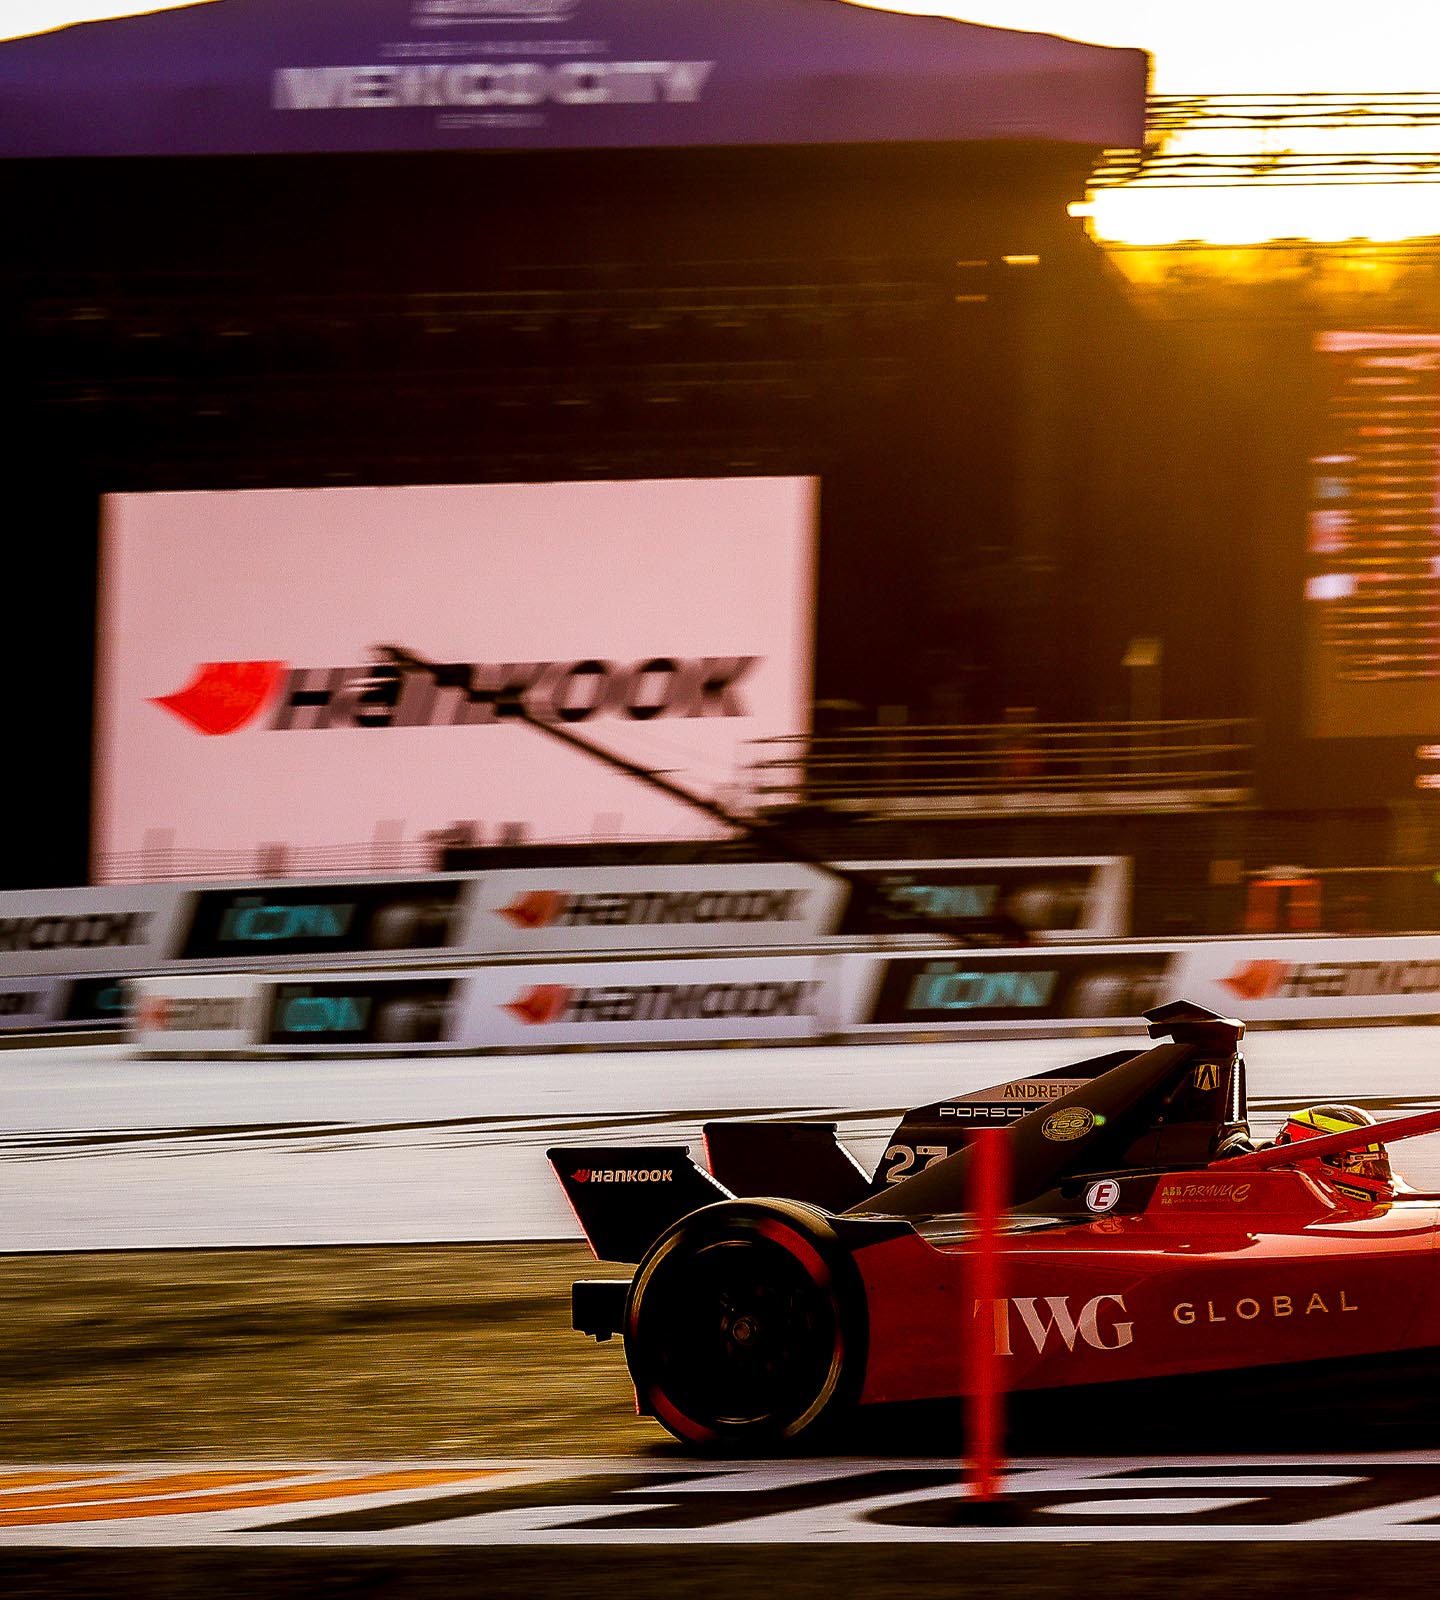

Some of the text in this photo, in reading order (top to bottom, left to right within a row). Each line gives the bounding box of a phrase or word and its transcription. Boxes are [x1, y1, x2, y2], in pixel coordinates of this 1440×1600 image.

[1003, 1084, 1079, 1098] ANDRETT
[939, 1107, 1039, 1118] PORSCH
[885, 1144, 948, 1184] 27
[1093, 1184, 1113, 1207] E
[973, 1290, 1359, 1356] TWG GLOBAL
